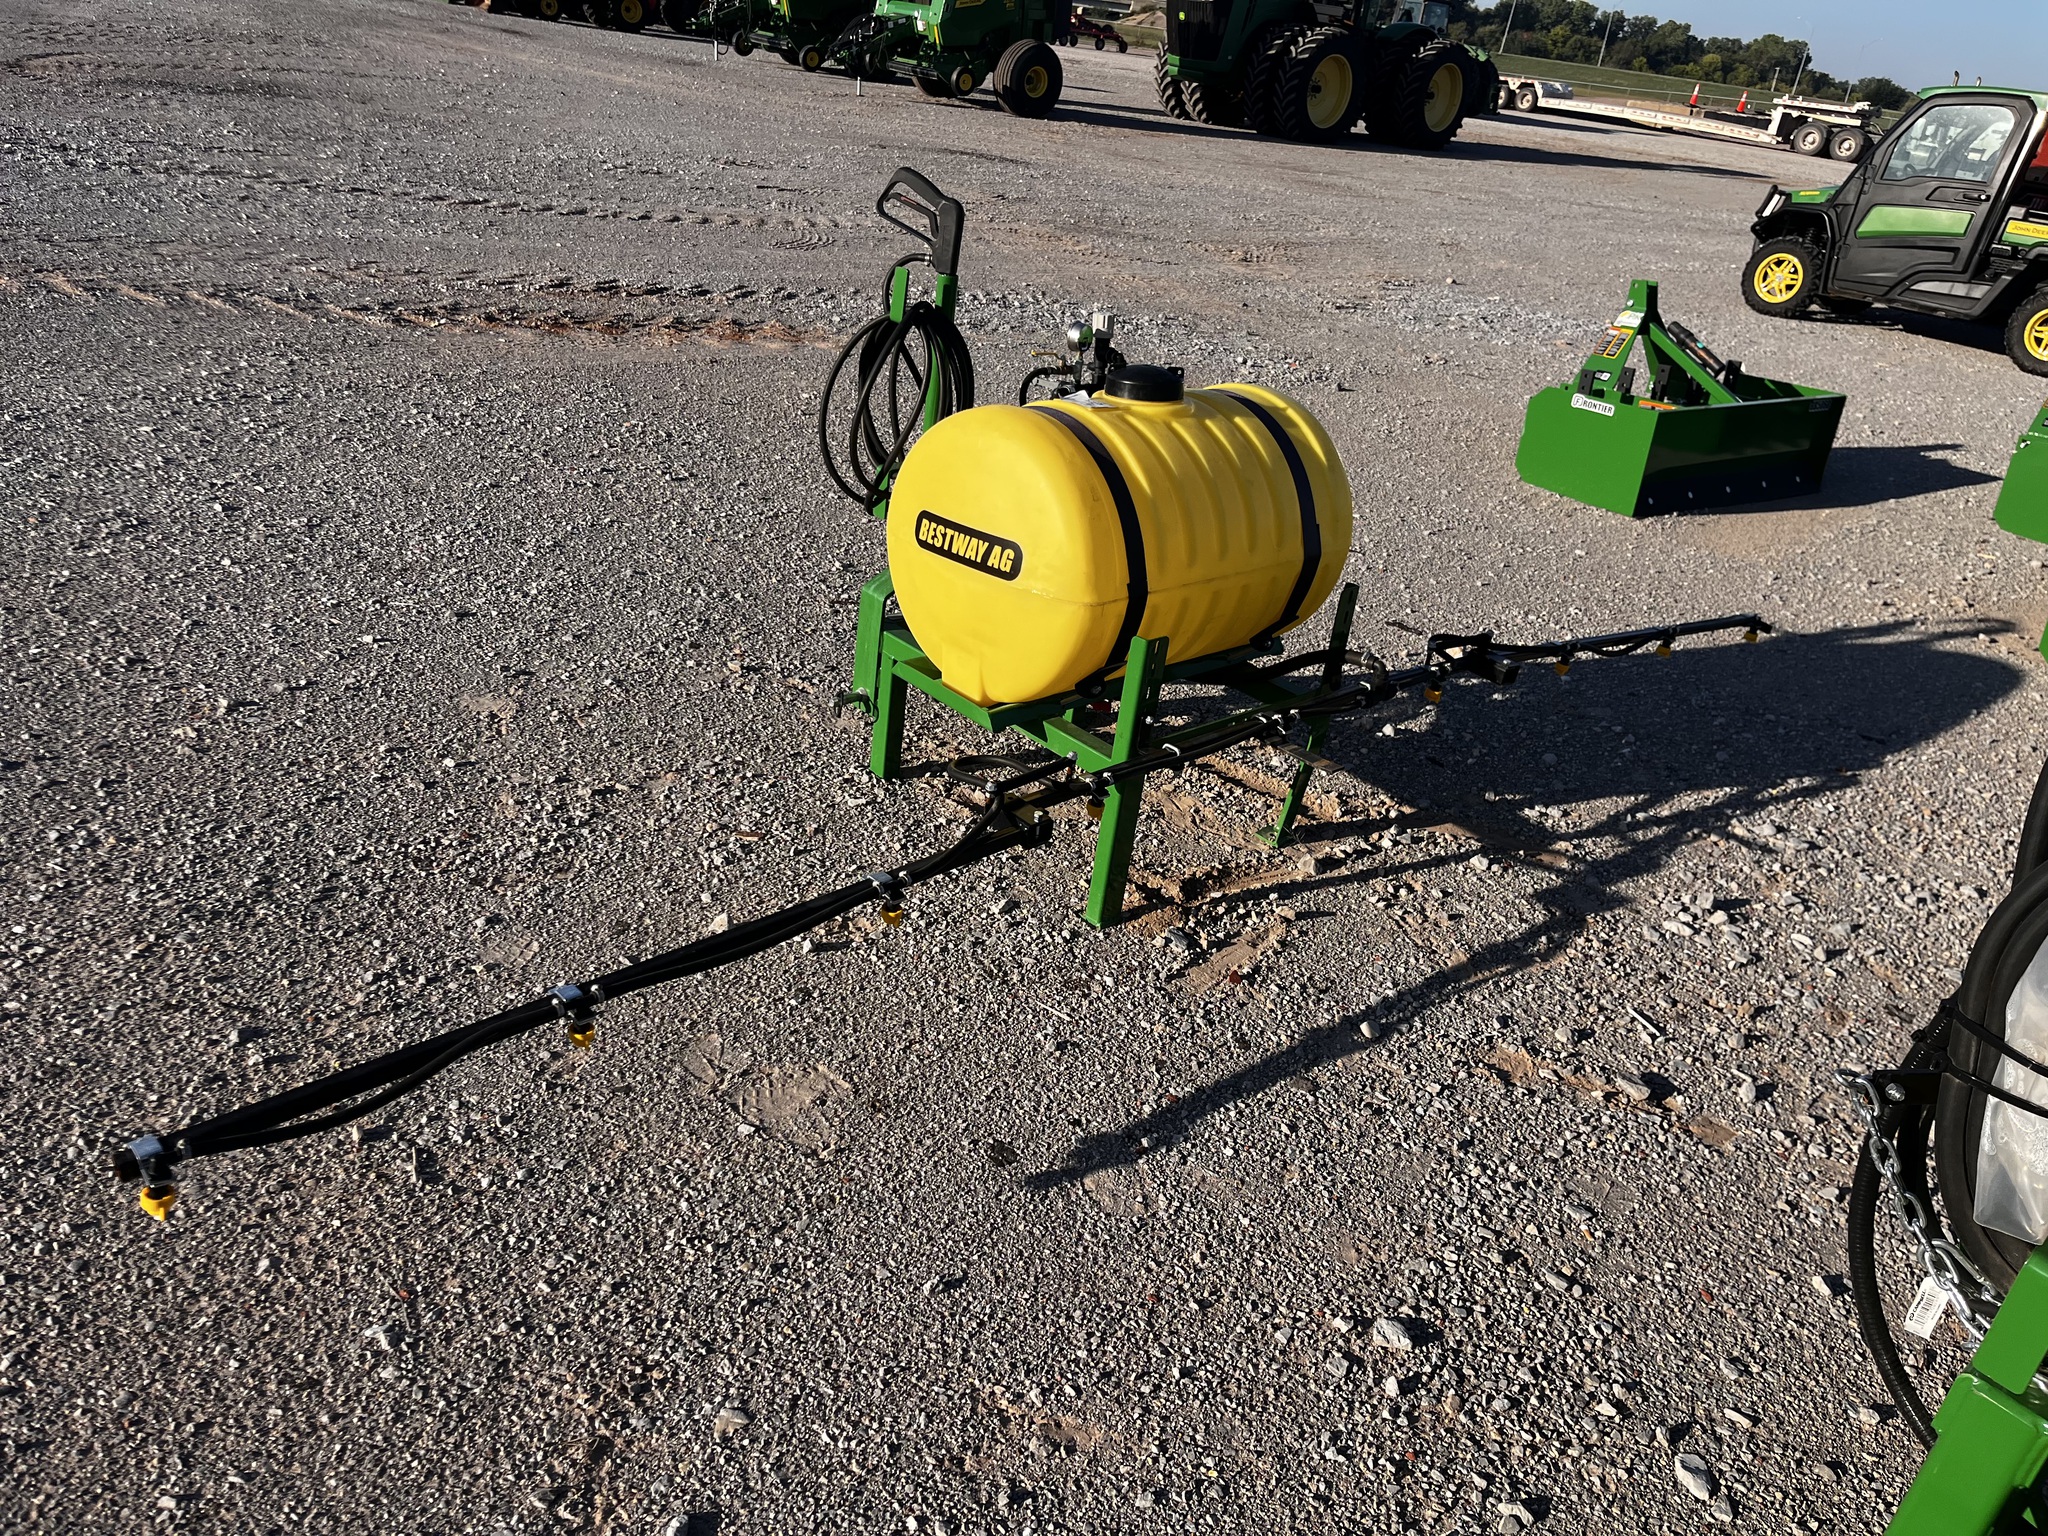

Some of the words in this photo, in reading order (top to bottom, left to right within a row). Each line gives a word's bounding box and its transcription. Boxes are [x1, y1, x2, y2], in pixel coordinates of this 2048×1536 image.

[2011, 225, 2031, 233] JOHN
[1573, 395, 1613, 414] FRONTIER
[918, 518, 989, 563] BESTWAY
[987, 545, 1015, 573] AG
